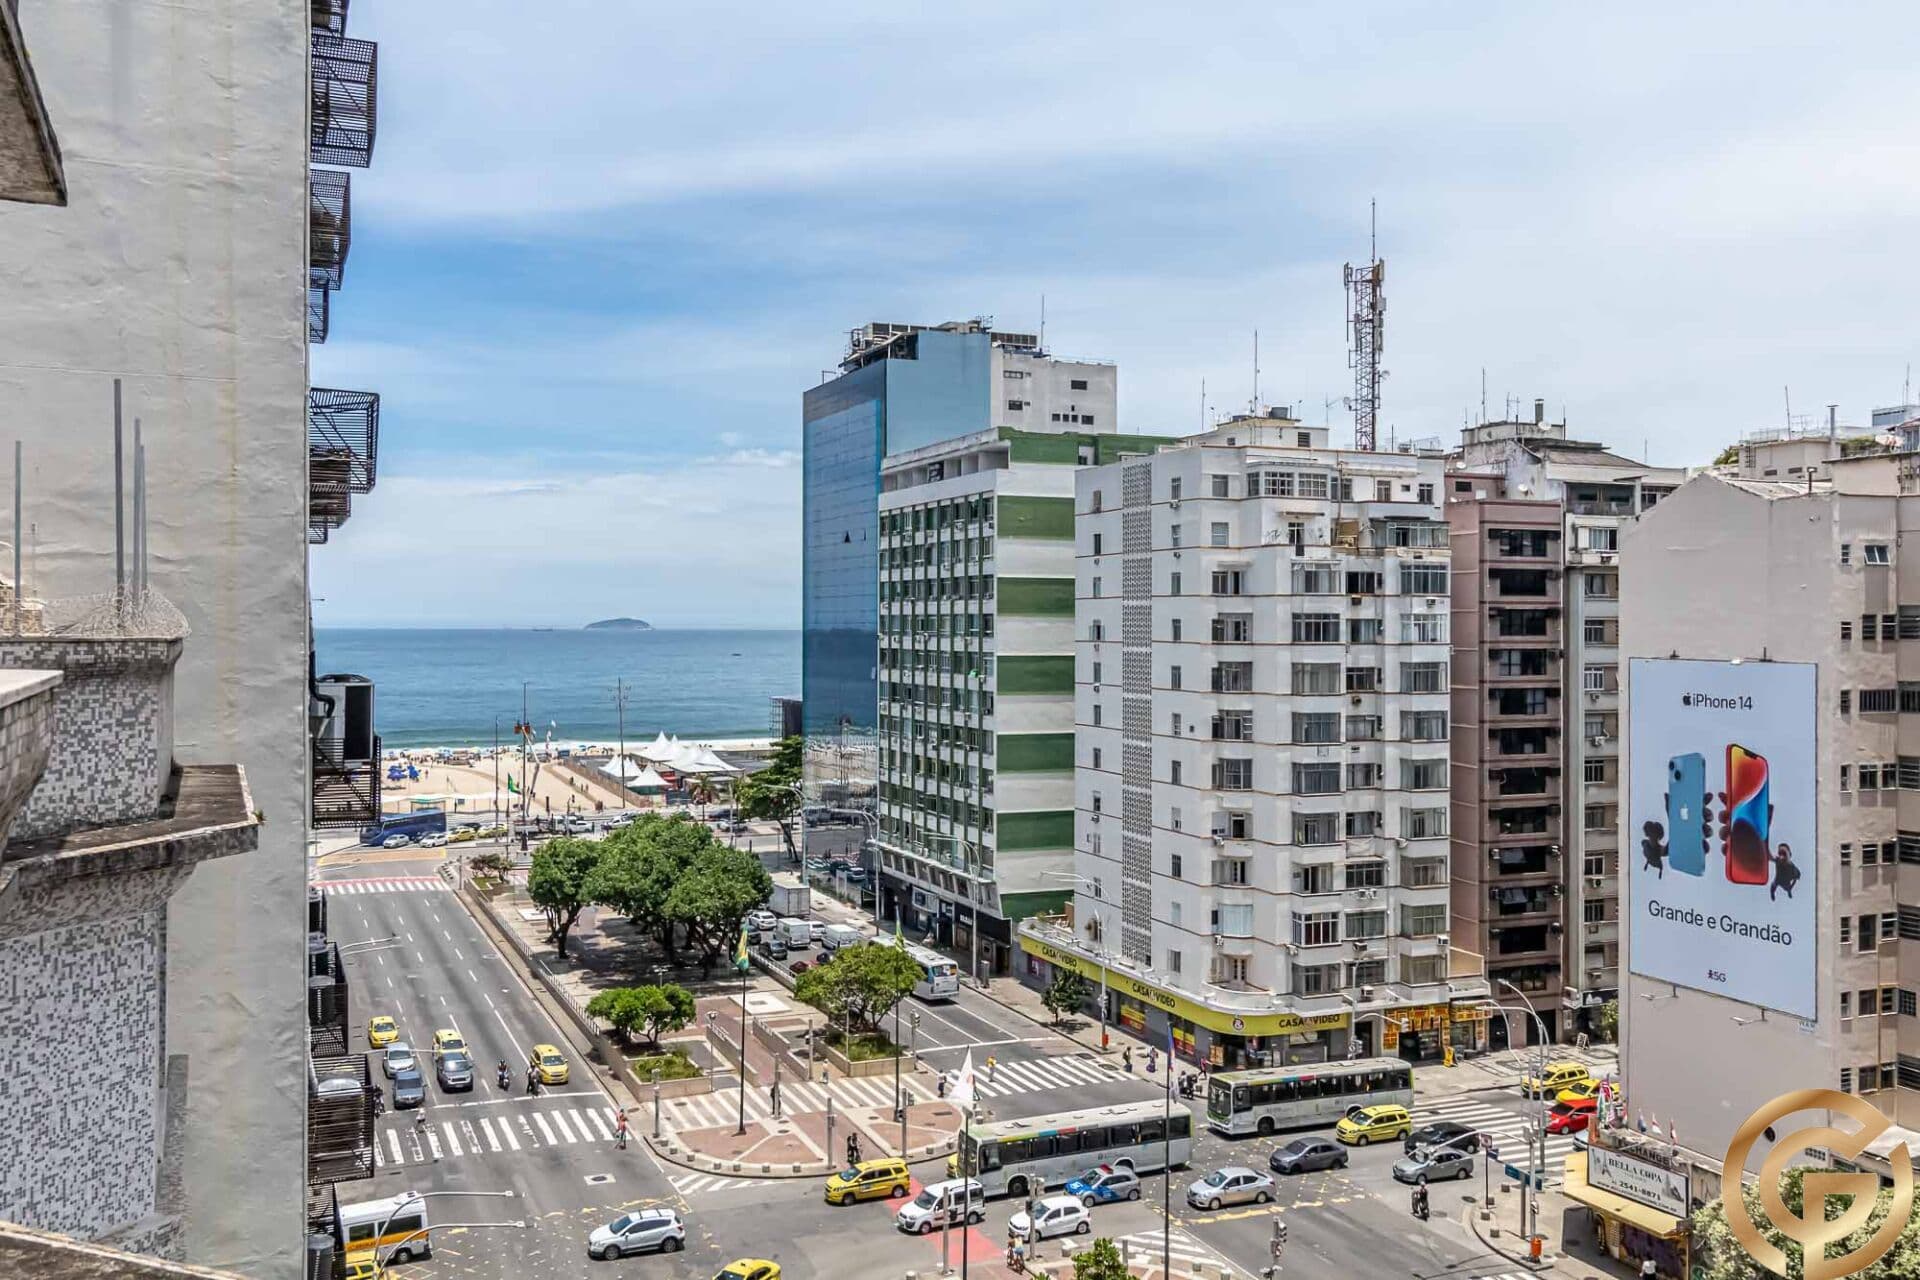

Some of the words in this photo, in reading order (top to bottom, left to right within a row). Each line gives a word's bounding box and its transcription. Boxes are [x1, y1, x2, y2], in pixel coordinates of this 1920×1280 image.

[1693, 693, 1737, 709] iPhone
[1738, 696, 1752, 710] 14
[1648, 900, 1704, 927] Grande
[1707, 916, 1717, 929] e
[1720, 915, 1792, 945] Grandão
